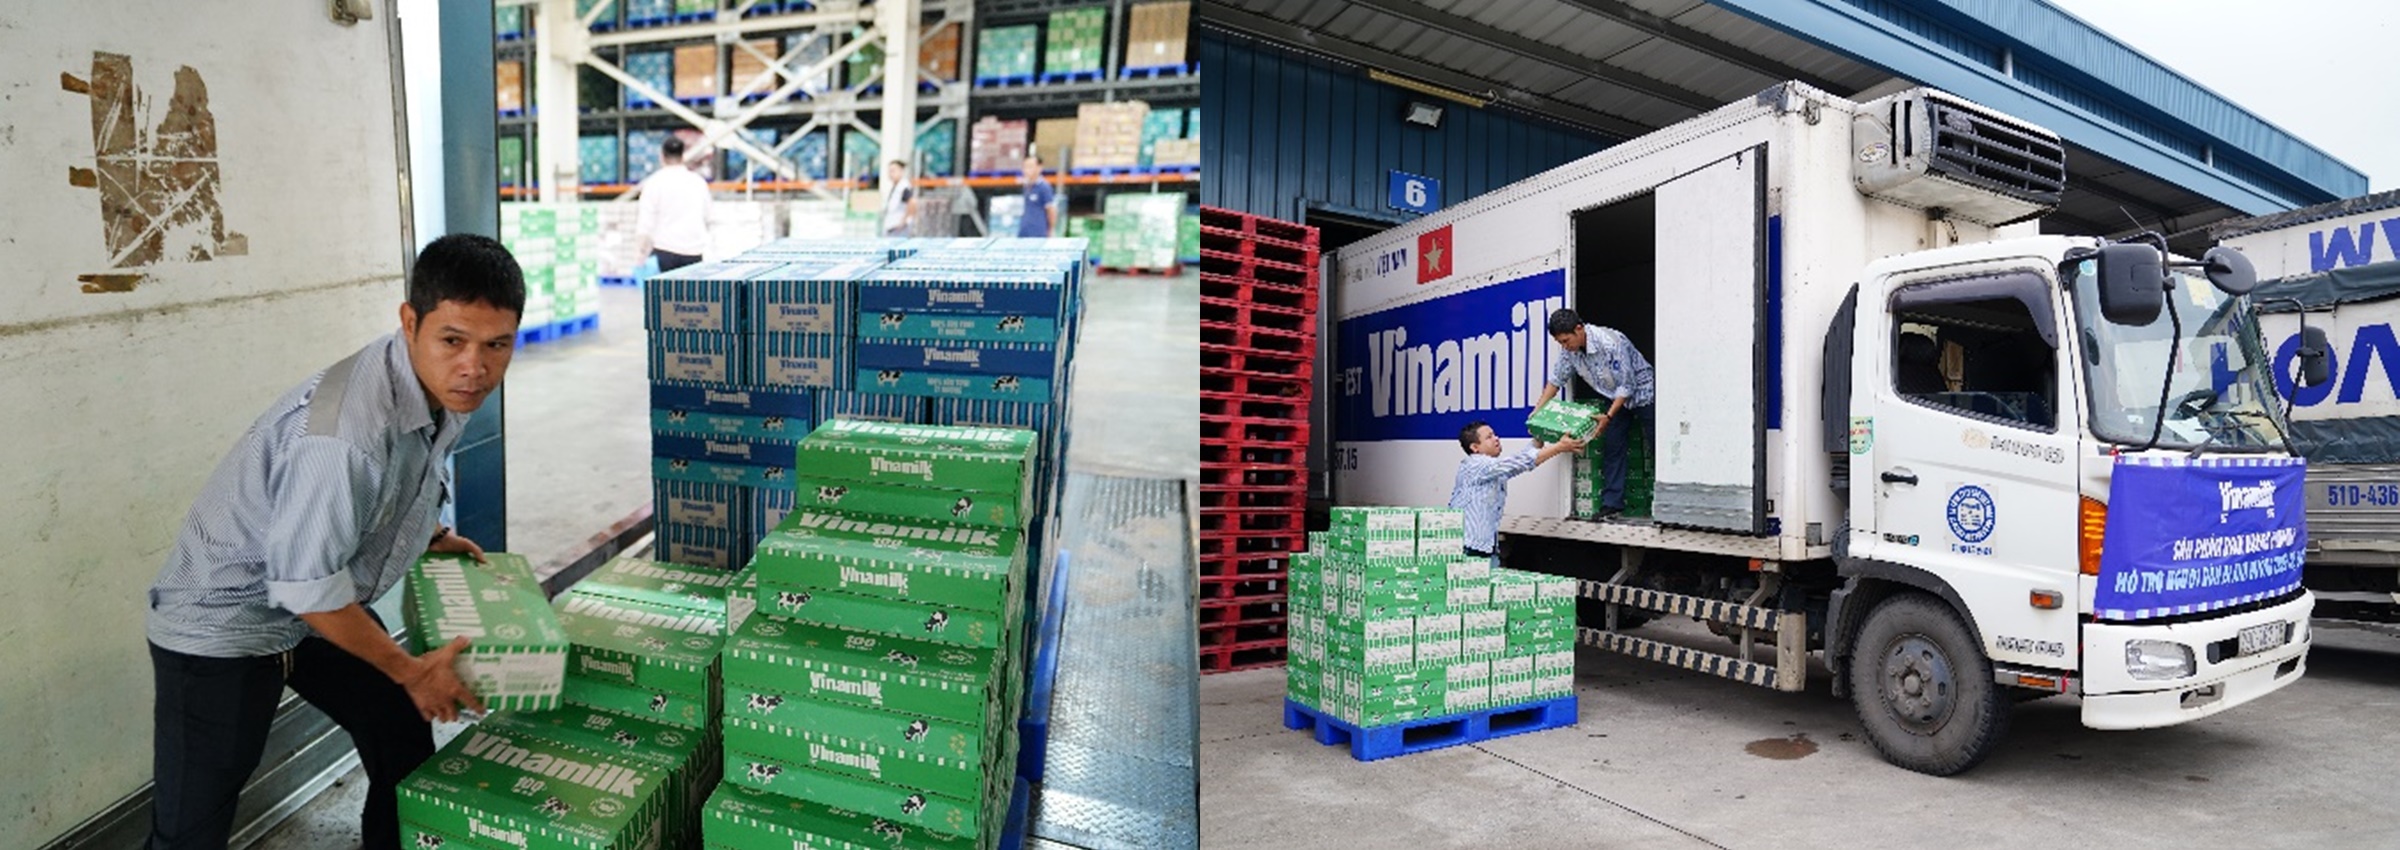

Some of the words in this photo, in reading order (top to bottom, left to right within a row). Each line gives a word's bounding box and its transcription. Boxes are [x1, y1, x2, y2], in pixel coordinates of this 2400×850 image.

[1405, 179, 1427, 207] 6
[928, 289, 985, 304] Vinamilk
[924, 348, 980, 363] Vinamilk
[833, 419, 1017, 442] Vinamilk
[870, 456, 933, 476] Vinamilk
[2328, 485, 2399, 506] 51D-436
[799, 513, 999, 547] Vinamilk
[612, 560, 731, 588] Vinami
[840, 565, 909, 589] Vinamilk
[421, 558, 486, 640] Vinamilk
[563, 596, 725, 637] Vinamilk
[845, 635, 876, 648] 100
[580, 655, 635, 681] Vinamilk
[810, 671, 883, 699] Vinamilk
[587, 714, 613, 727] 100
[461, 731, 646, 798] Vinamilk
[810, 743, 881, 773] Vinamilk
[518, 776, 546, 793] 100
[468, 817, 528, 848] Vinamilk
